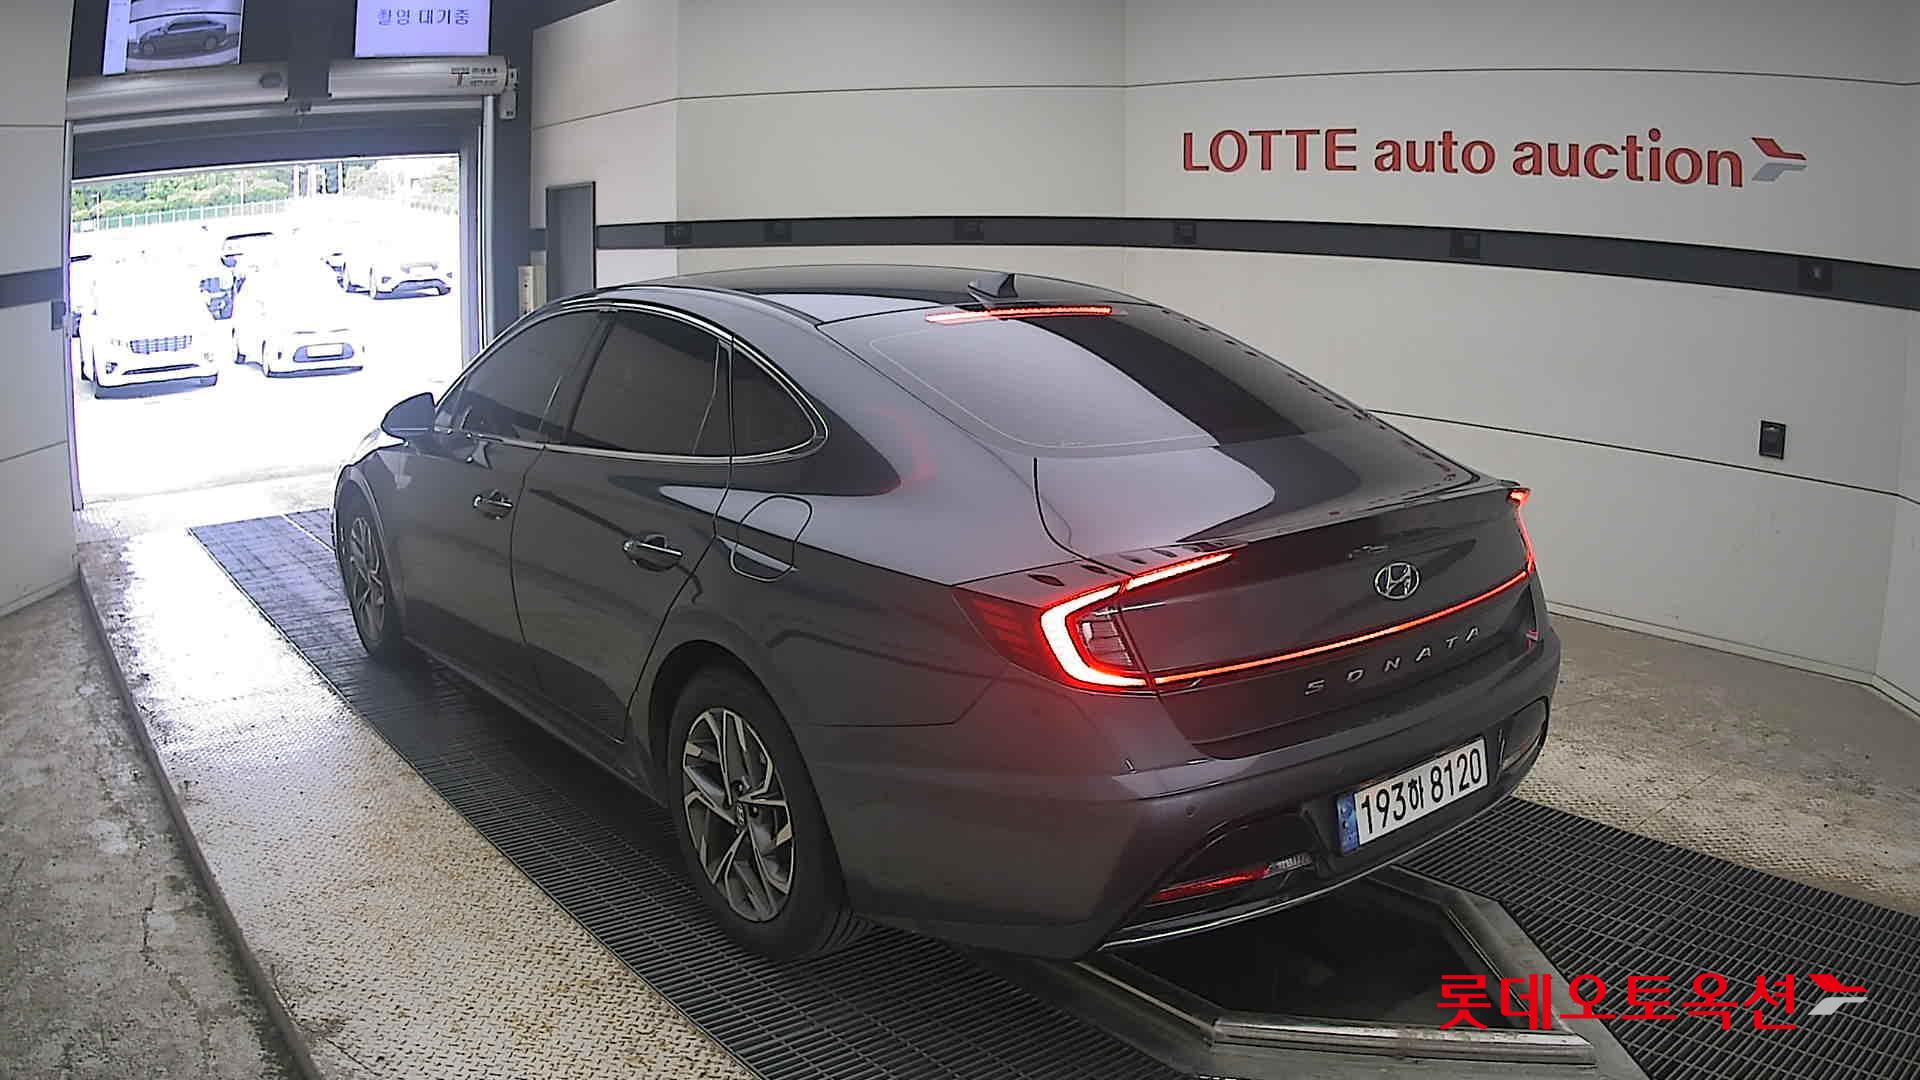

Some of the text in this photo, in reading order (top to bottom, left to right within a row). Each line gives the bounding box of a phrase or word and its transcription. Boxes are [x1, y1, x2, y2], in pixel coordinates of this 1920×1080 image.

[418, 8, 470, 26] 대기중
[1183, 127, 1743, 188] LOTTE auto auction
[1304, 627, 1480, 695] SONATA
[1361, 748, 1482, 834] 193하 8120
